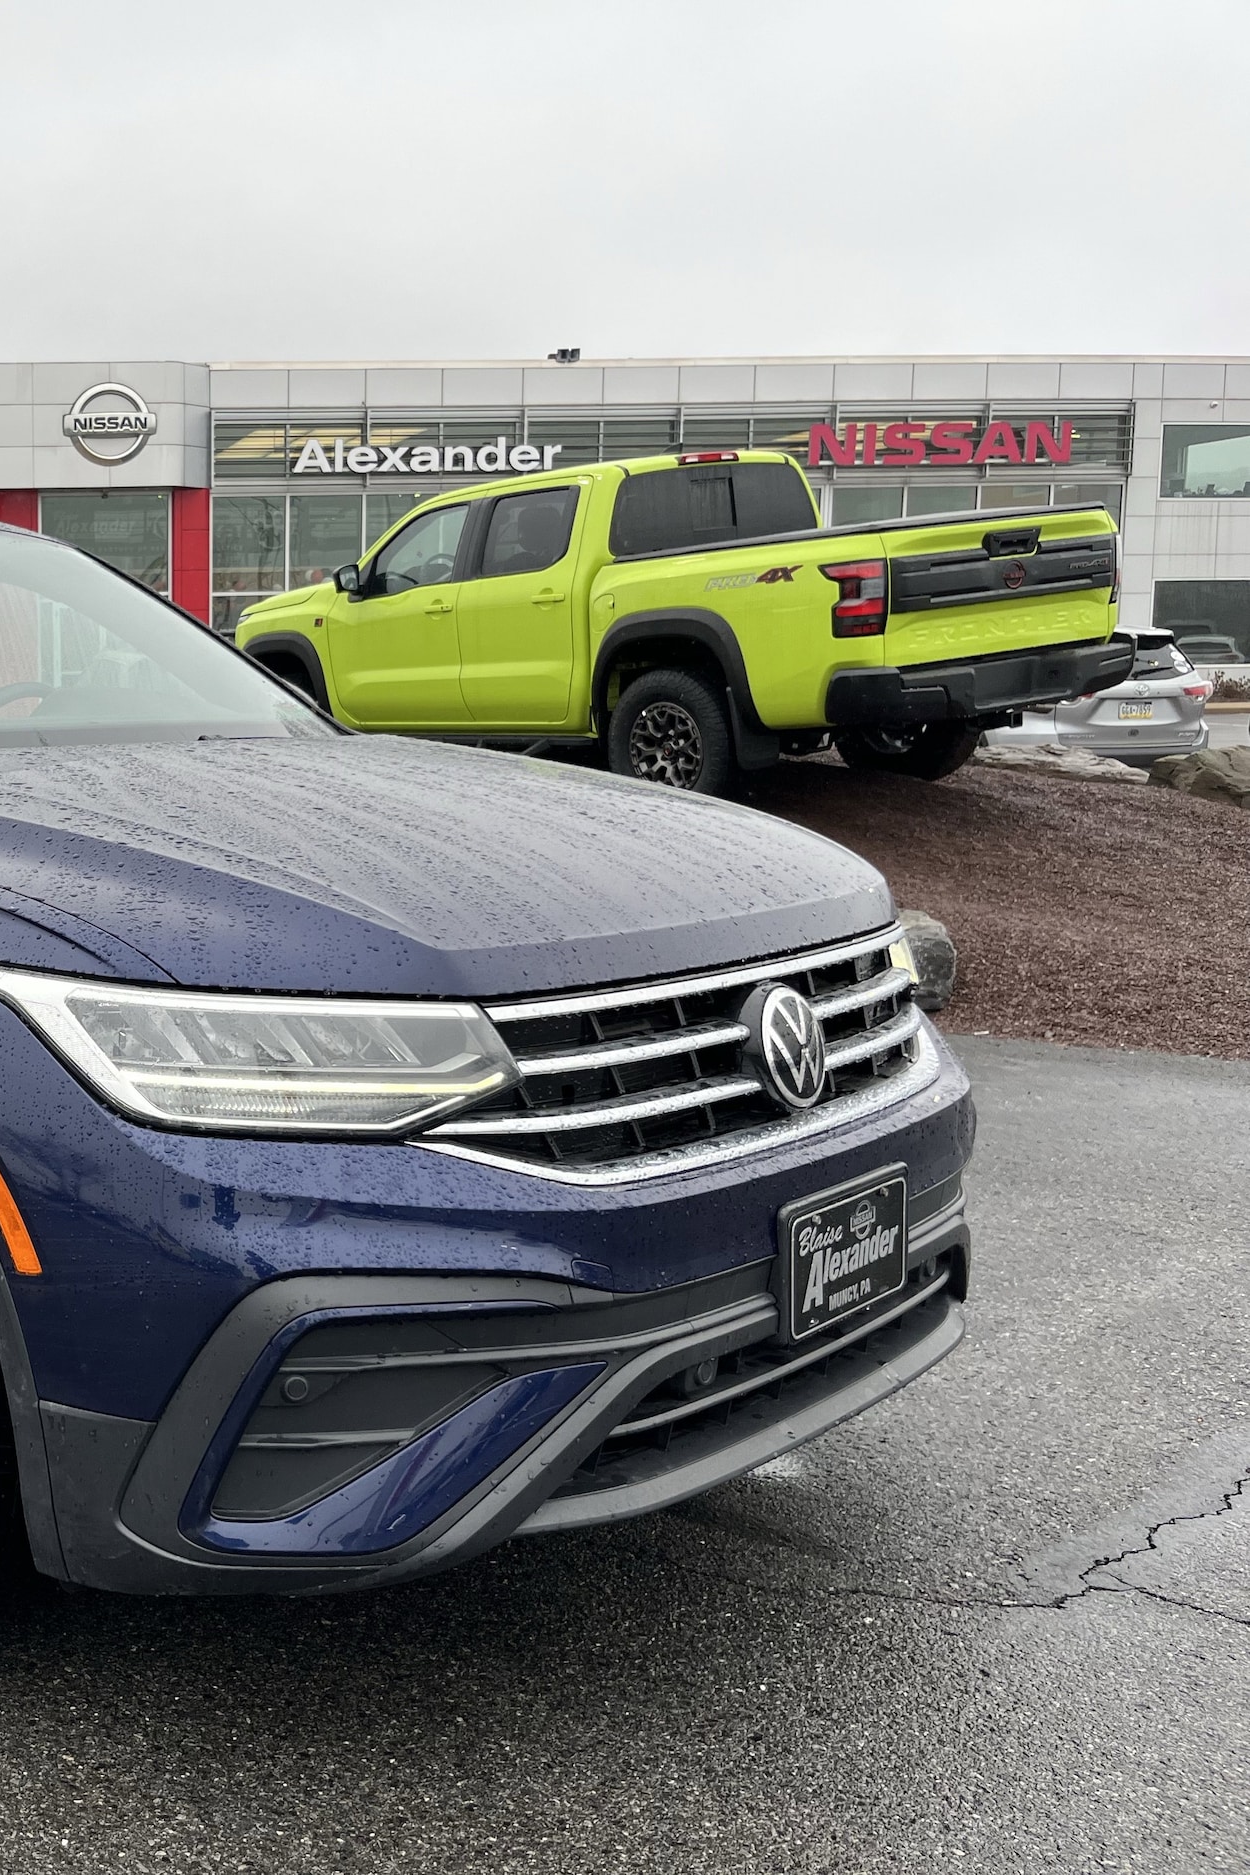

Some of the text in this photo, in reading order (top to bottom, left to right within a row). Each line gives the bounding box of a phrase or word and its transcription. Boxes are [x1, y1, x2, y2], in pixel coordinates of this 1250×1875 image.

[73, 416, 148, 431] NISSAN
[293, 437, 562, 473] Alexander
[808, 421, 1073, 466] NISSAN
[798, 1224, 844, 1257] Blaise
[802, 1224, 899, 1313] Alexander
[828, 1278, 871, 1312] MUNCY, PA
